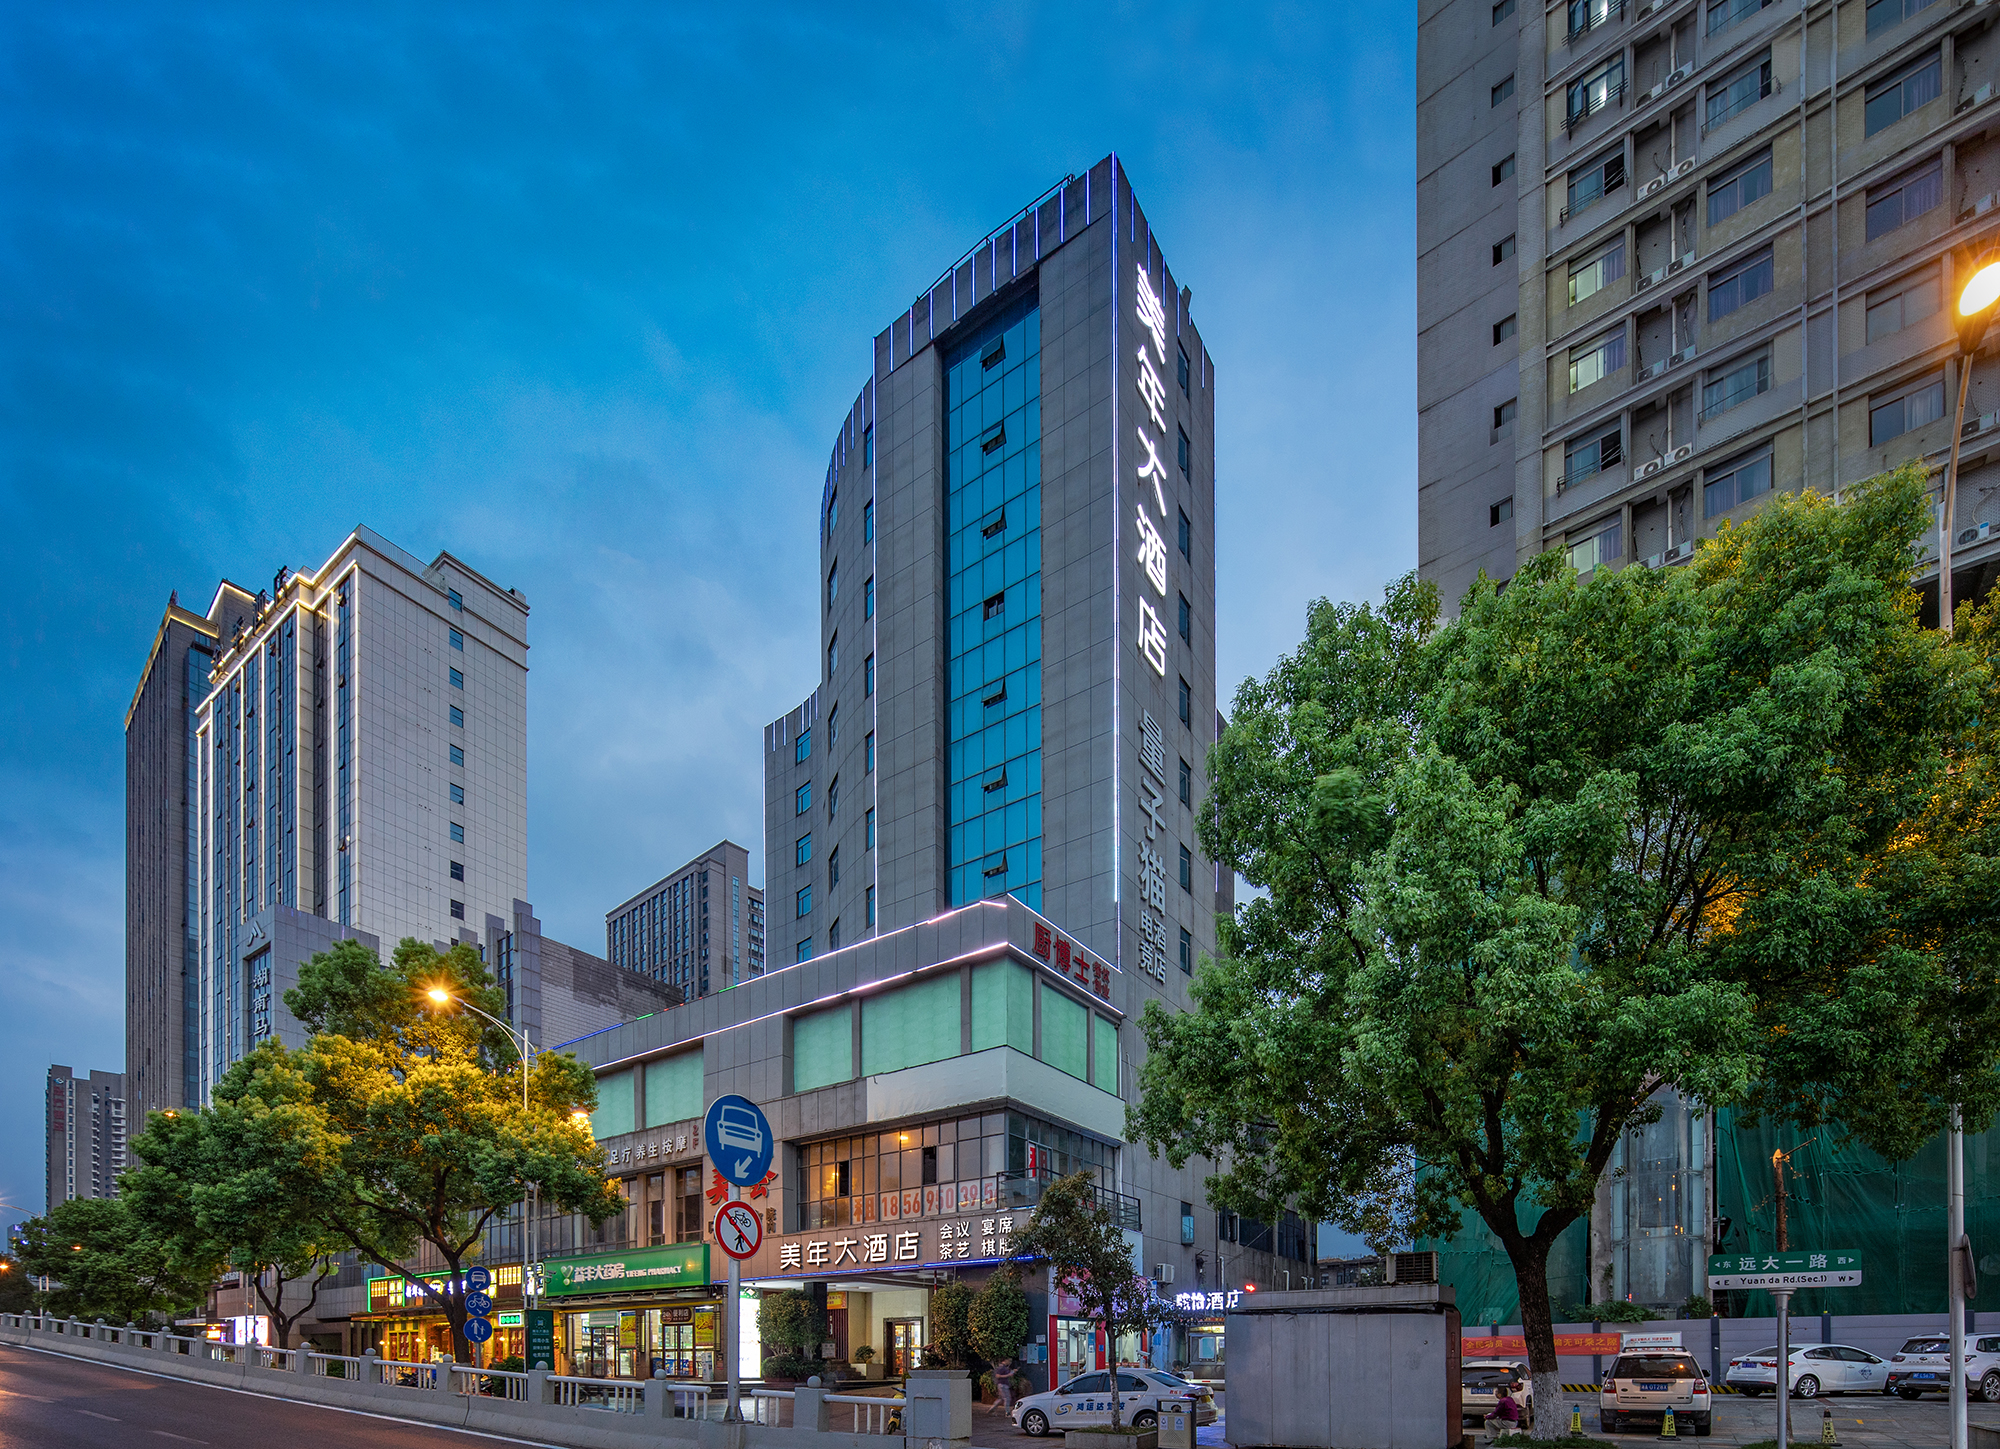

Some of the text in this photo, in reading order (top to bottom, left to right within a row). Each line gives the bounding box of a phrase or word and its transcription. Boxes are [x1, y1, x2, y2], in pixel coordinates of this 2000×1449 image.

[1136, 262, 1166, 677] 美年大酒店
[1139, 707, 1166, 917] 量子猫
[1033, 921, 1090, 985] 厨博士
[636, 1142, 659, 1160] 养生
[662, 1135, 687, 1155] 按摩
[853, 1196, 876, 1223] 租
[940, 1216, 1014, 1240] 会议 宴席
[780, 1230, 920, 1271] 美年大酒店
[939, 1241, 971, 1260] 茶艺
[1722, 1254, 1847, 1271] 东 远大一路 西
[574, 1263, 625, 1283] 益丰大药房
[625, 1265, 682, 1278] YIFENG PHARMACY
[1740, 1277, 1766, 1285] Yuan
[1768, 1276, 1780, 1284] da
[1838, 1275, 1846, 1283] W
[1466, 1339, 1504, 1349] 全民动员
